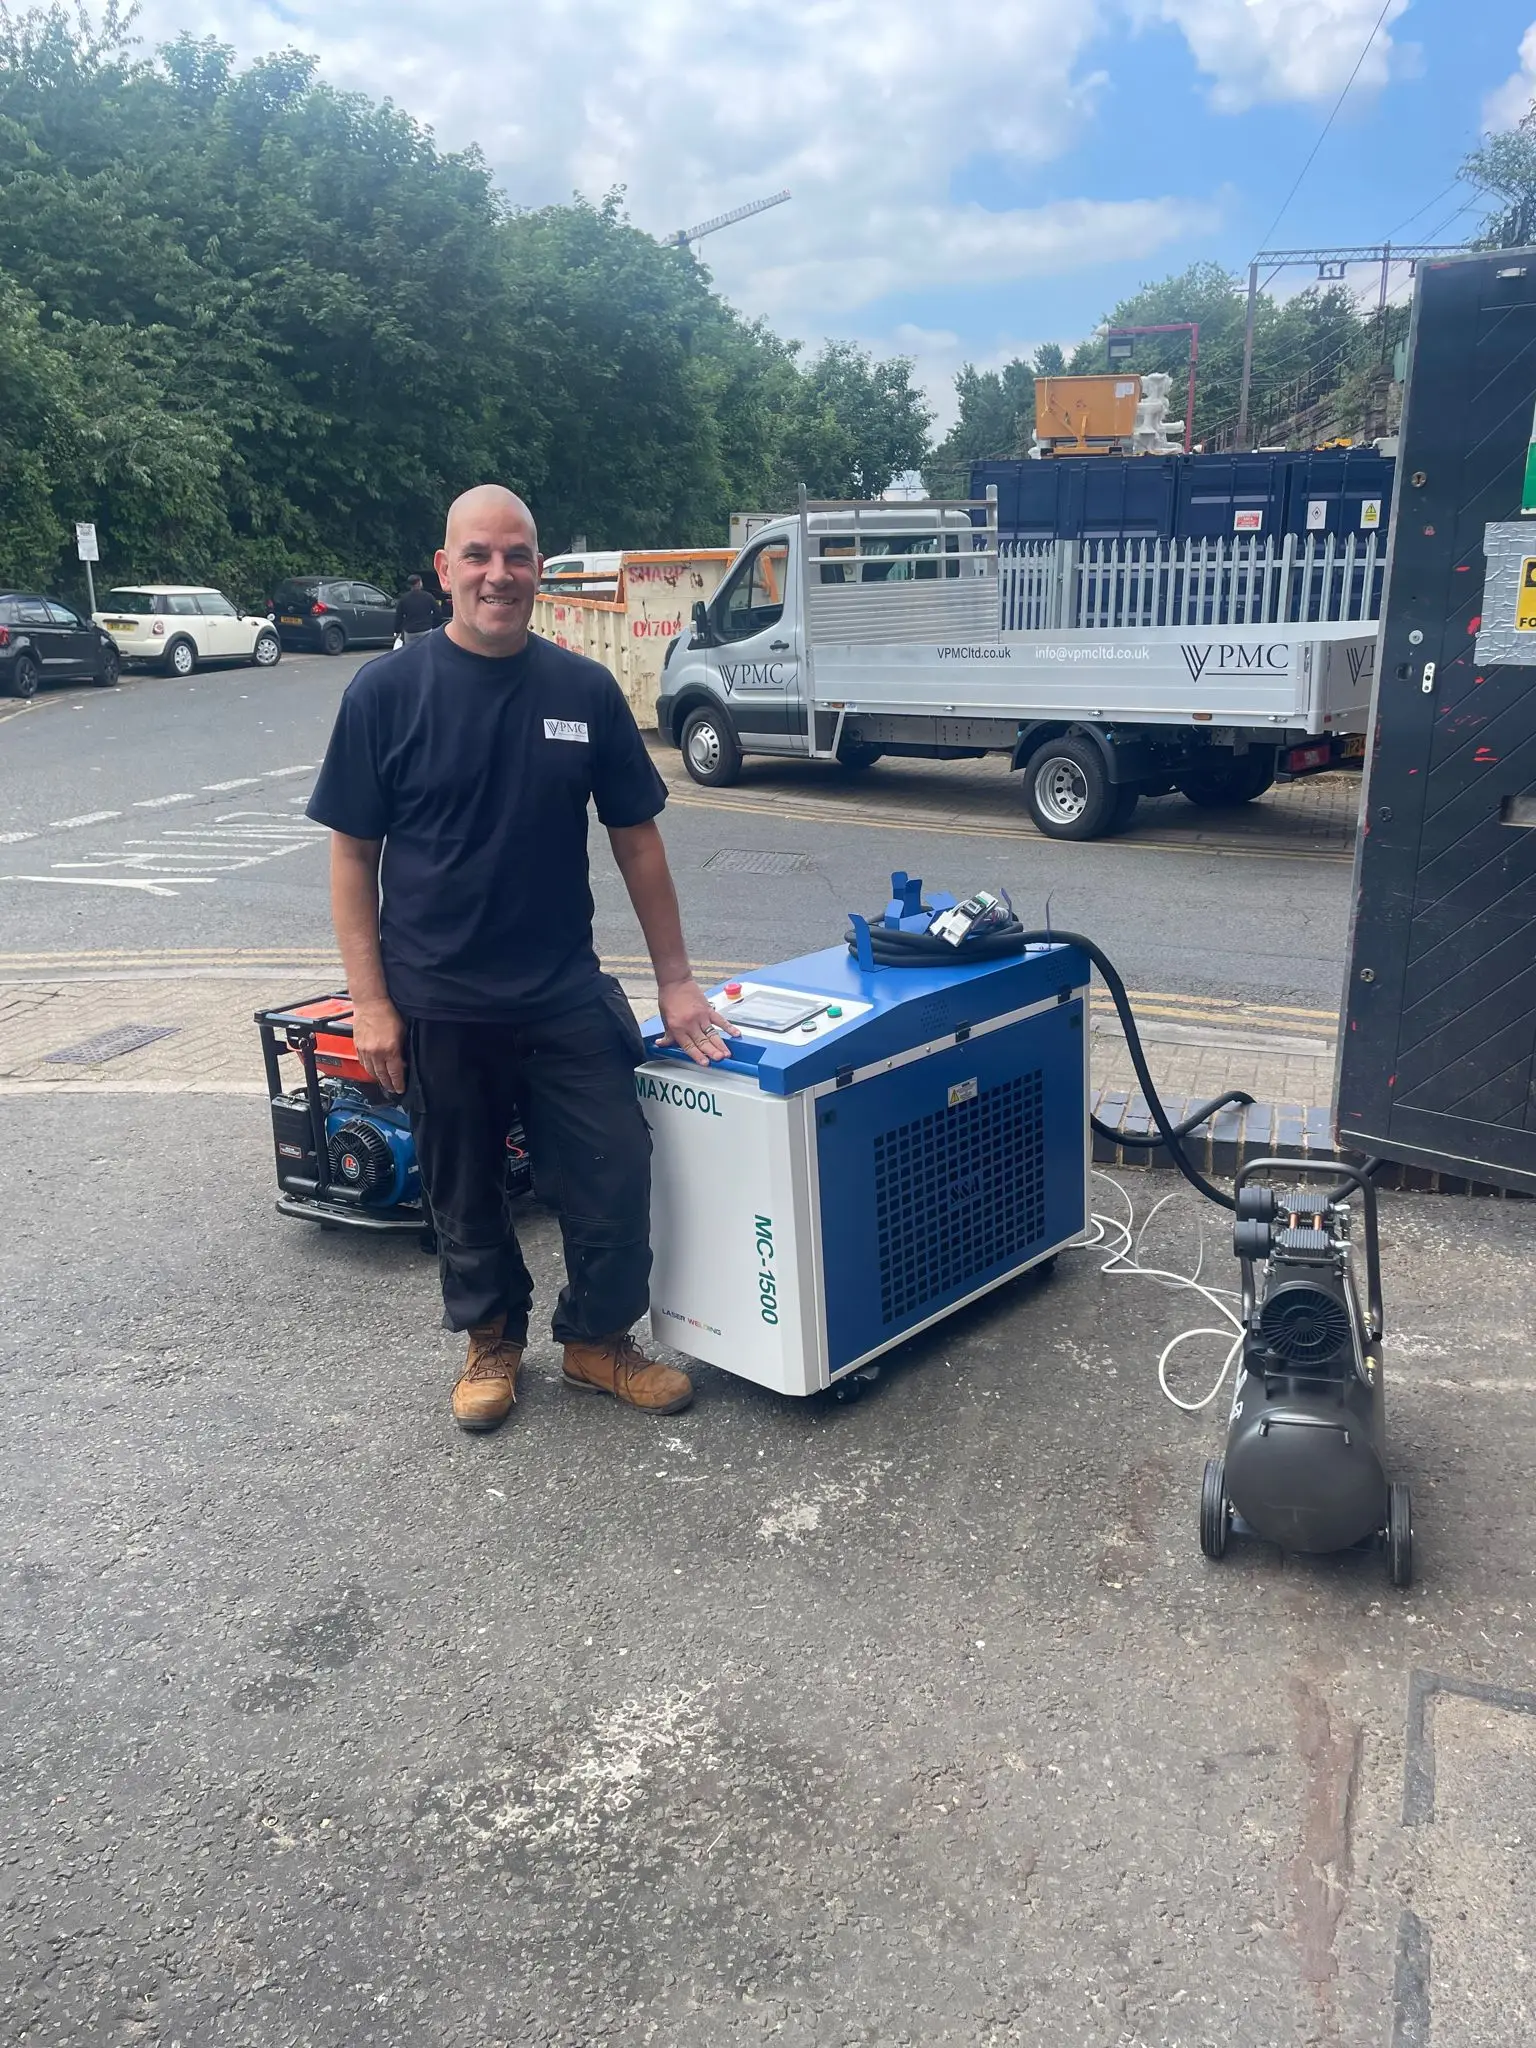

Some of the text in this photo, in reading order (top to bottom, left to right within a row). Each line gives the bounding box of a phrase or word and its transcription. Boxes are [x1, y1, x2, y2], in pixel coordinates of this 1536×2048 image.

[937, 645, 1150, 662] VPMCltd.co.uk info@vpmcltd.co.uk
[1180, 643, 1289, 683] VPMC
[718, 662, 783, 697] VPMC
[545, 720, 587, 736] VPMC
[635, 1075, 722, 1116] MAXCOOL
[754, 1213, 779, 1325] MC-1500
[661, 1307, 686, 1321] LASER
